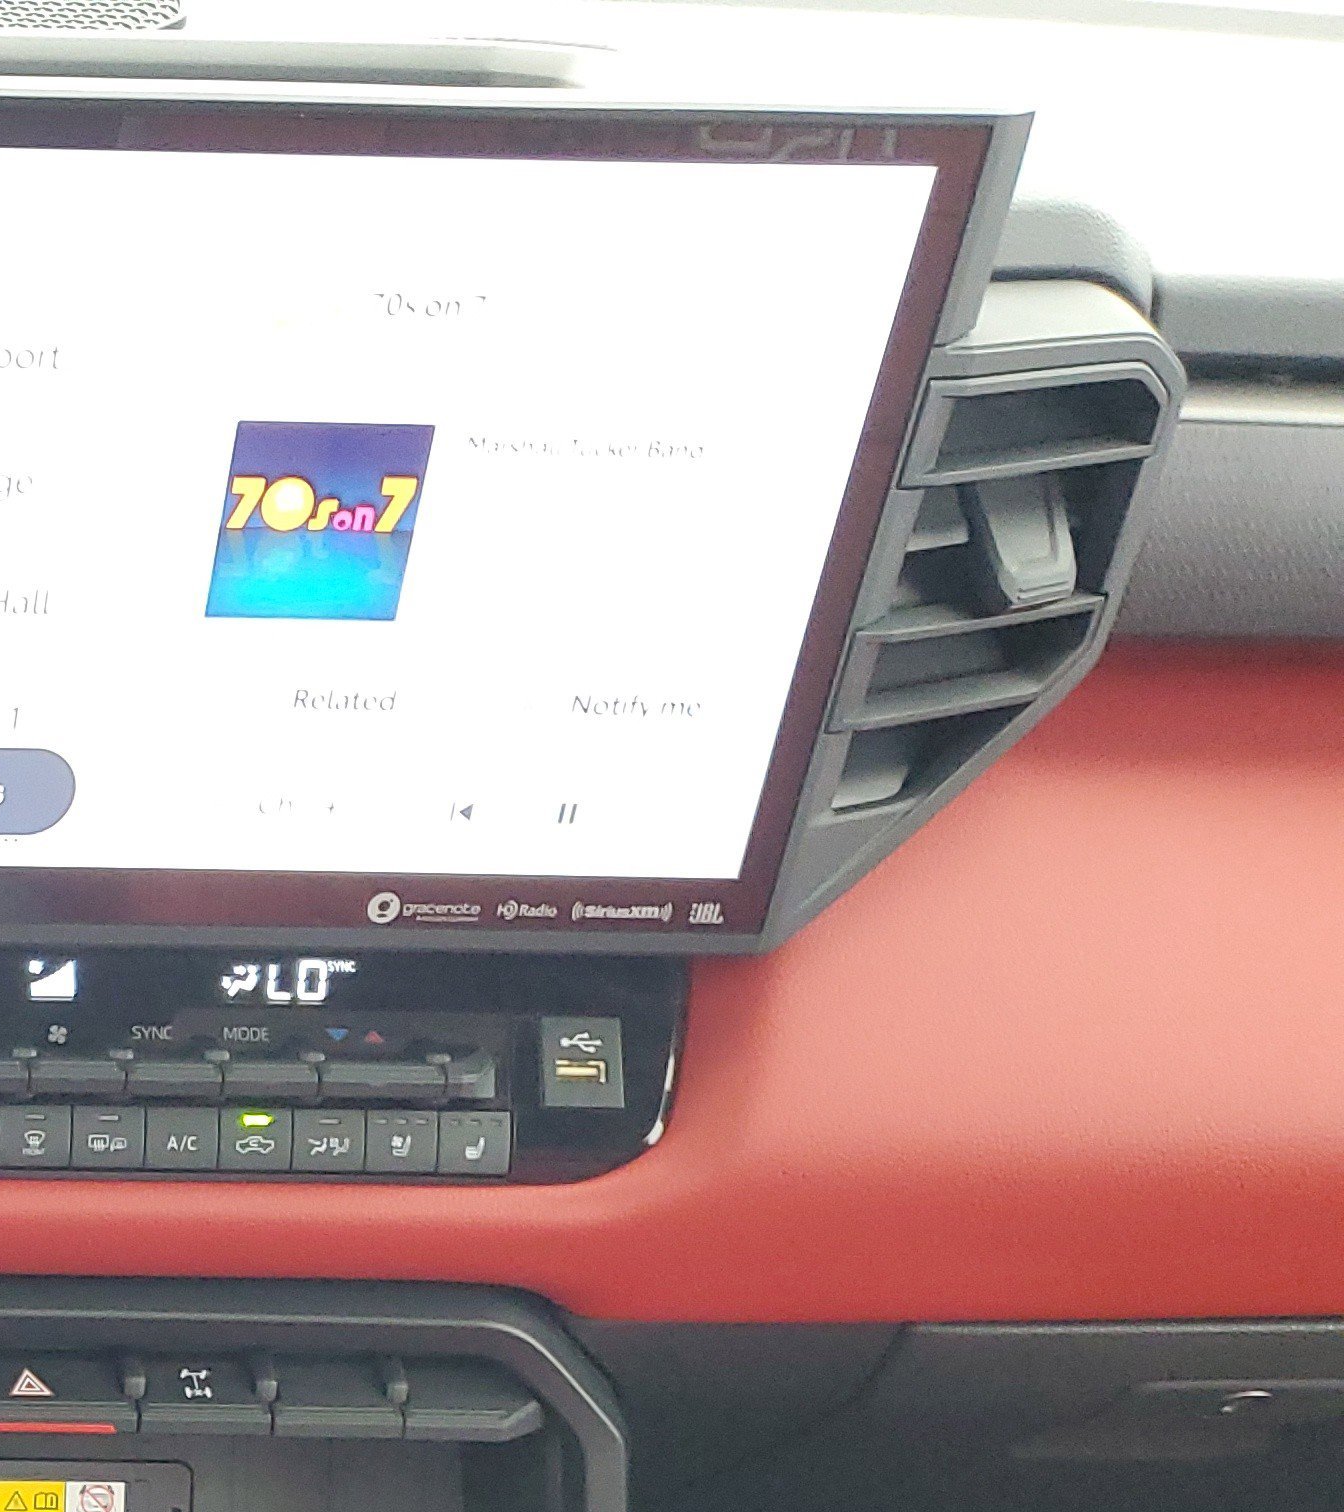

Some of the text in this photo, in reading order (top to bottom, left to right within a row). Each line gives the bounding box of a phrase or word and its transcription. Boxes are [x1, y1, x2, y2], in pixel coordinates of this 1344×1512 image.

[293, 689, 703, 718] Related Notify me
[519, 903, 558, 918] Radio
[265, 958, 357, 1004] LO SYNC
[131, 1025, 174, 1042] SYNC
[223, 1025, 271, 1042] MODE
[166, 1133, 198, 1152] A/C
